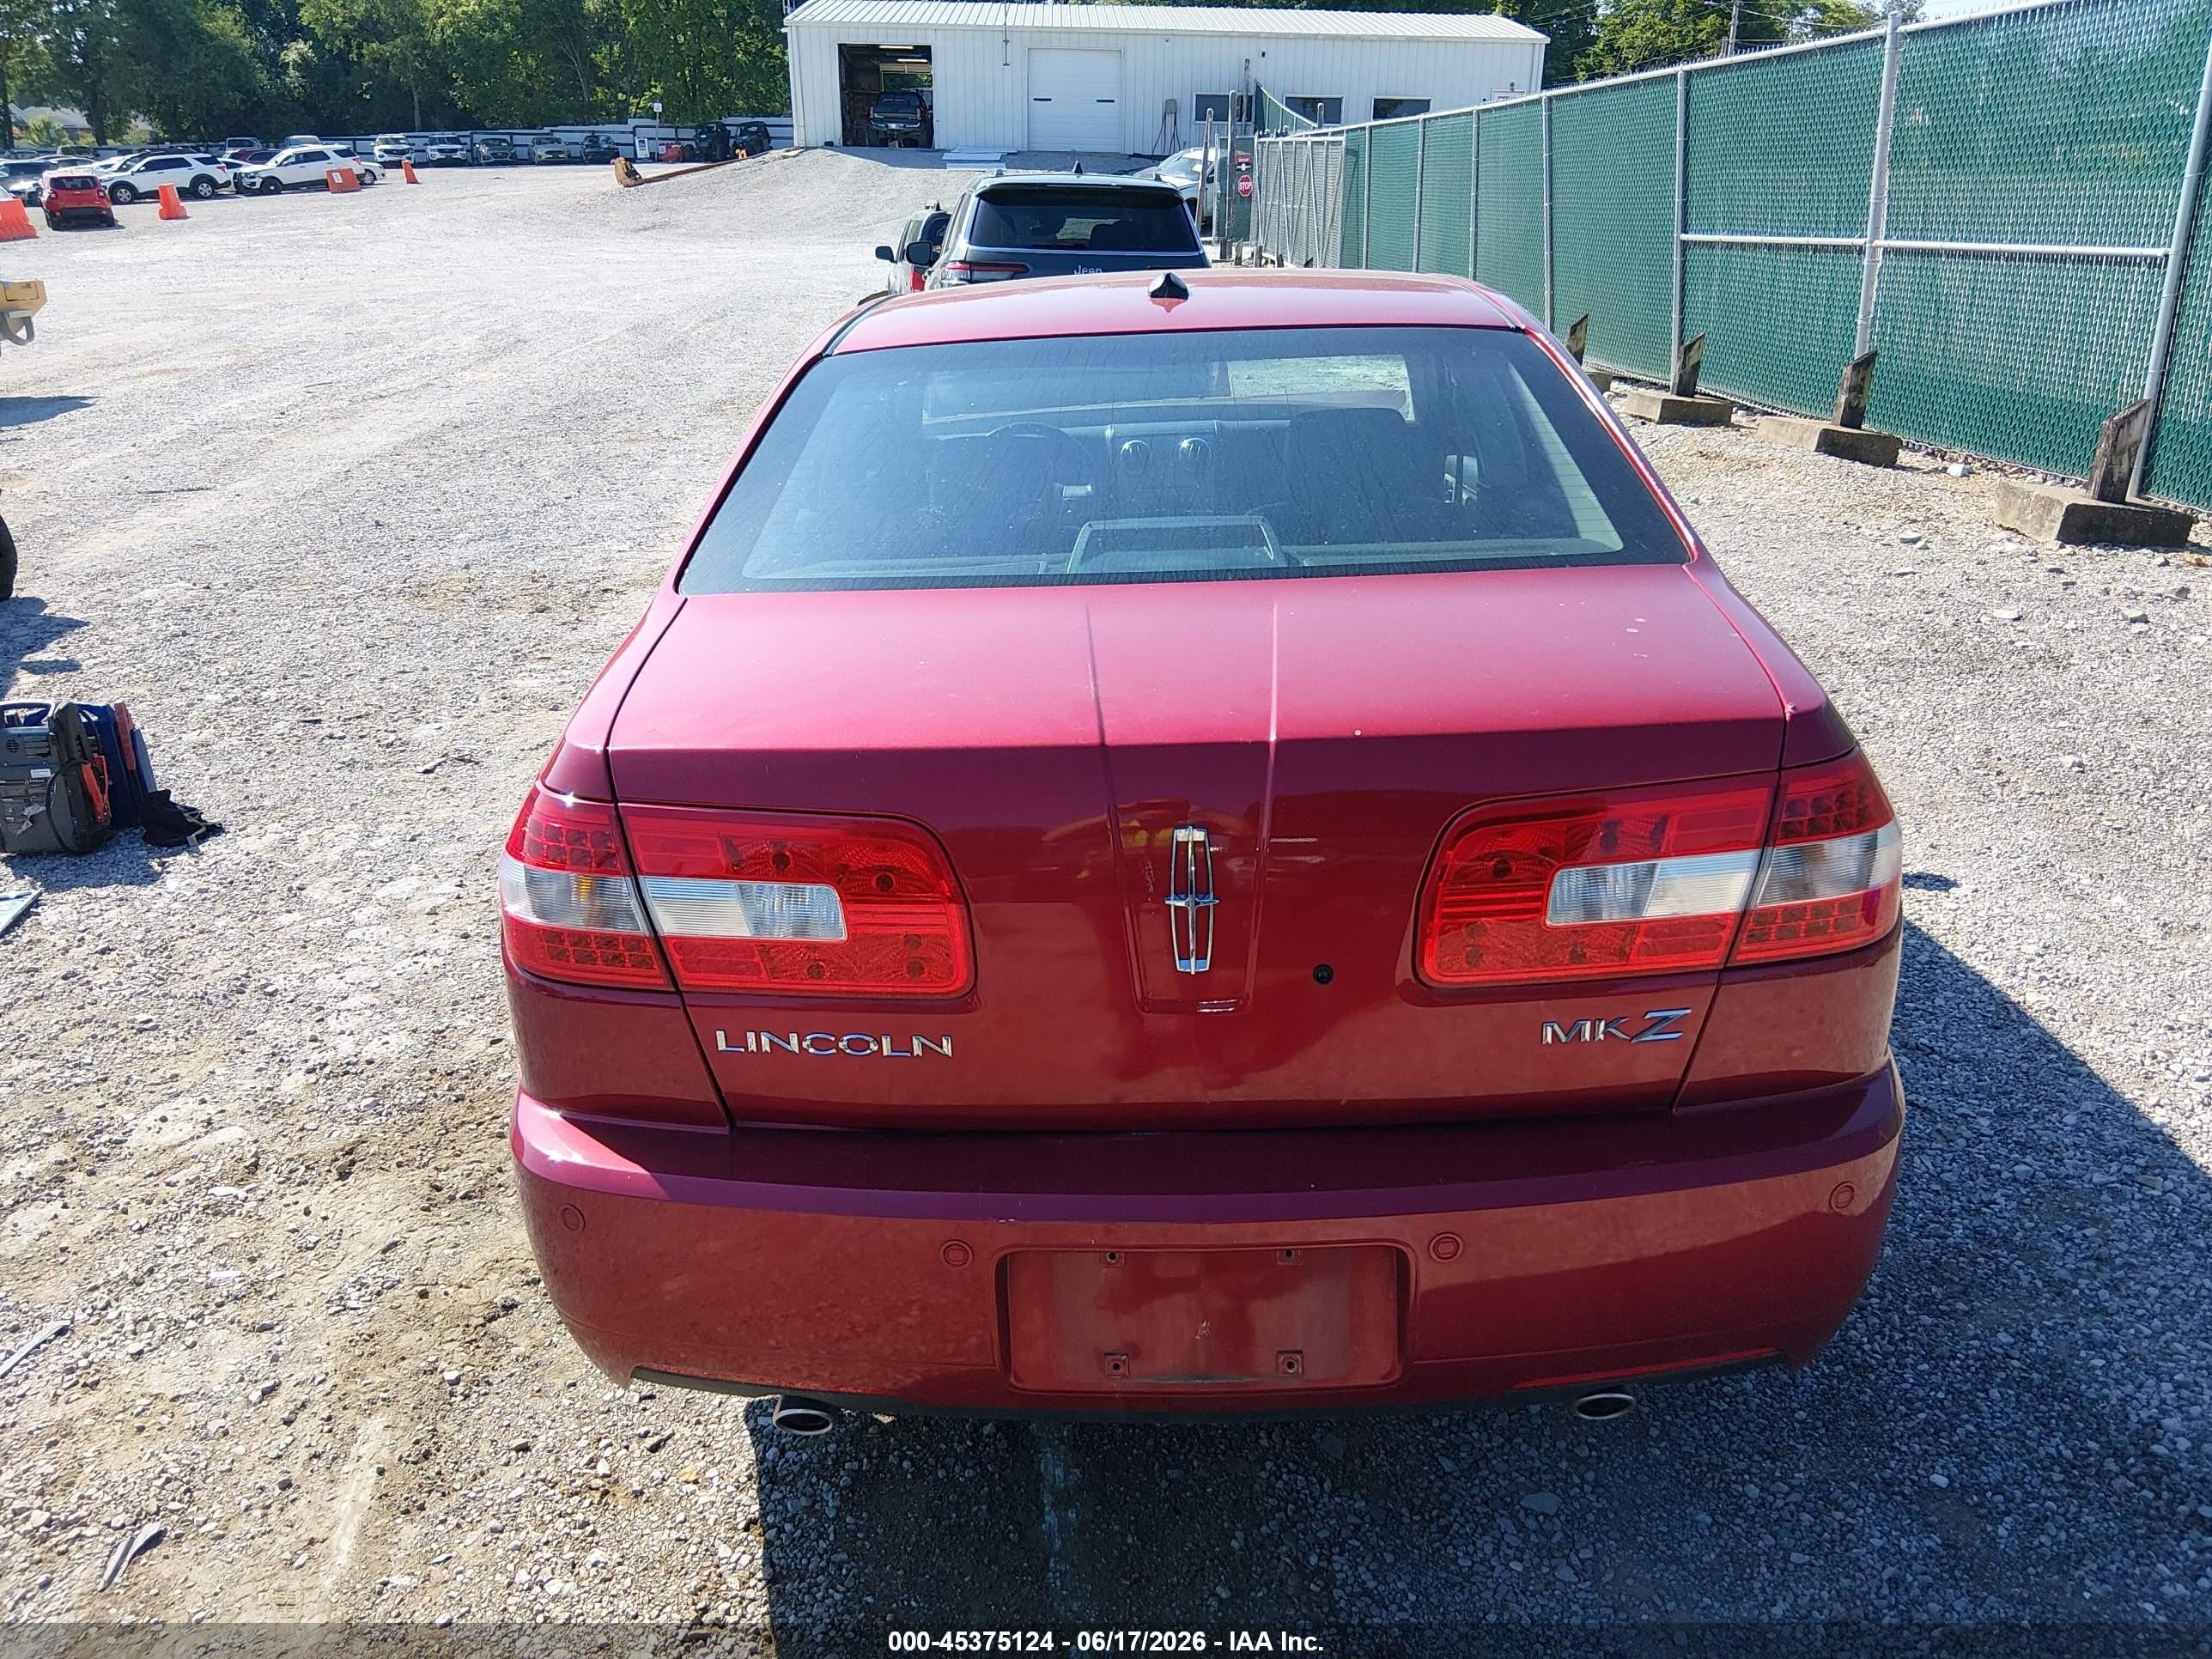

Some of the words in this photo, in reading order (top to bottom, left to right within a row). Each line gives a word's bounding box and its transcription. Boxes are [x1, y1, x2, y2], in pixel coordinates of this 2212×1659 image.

[1239, 181, 1252, 191] STOP
[1542, 1007, 1692, 1045] MKZ
[715, 1030, 953, 1057] LINCOLN
